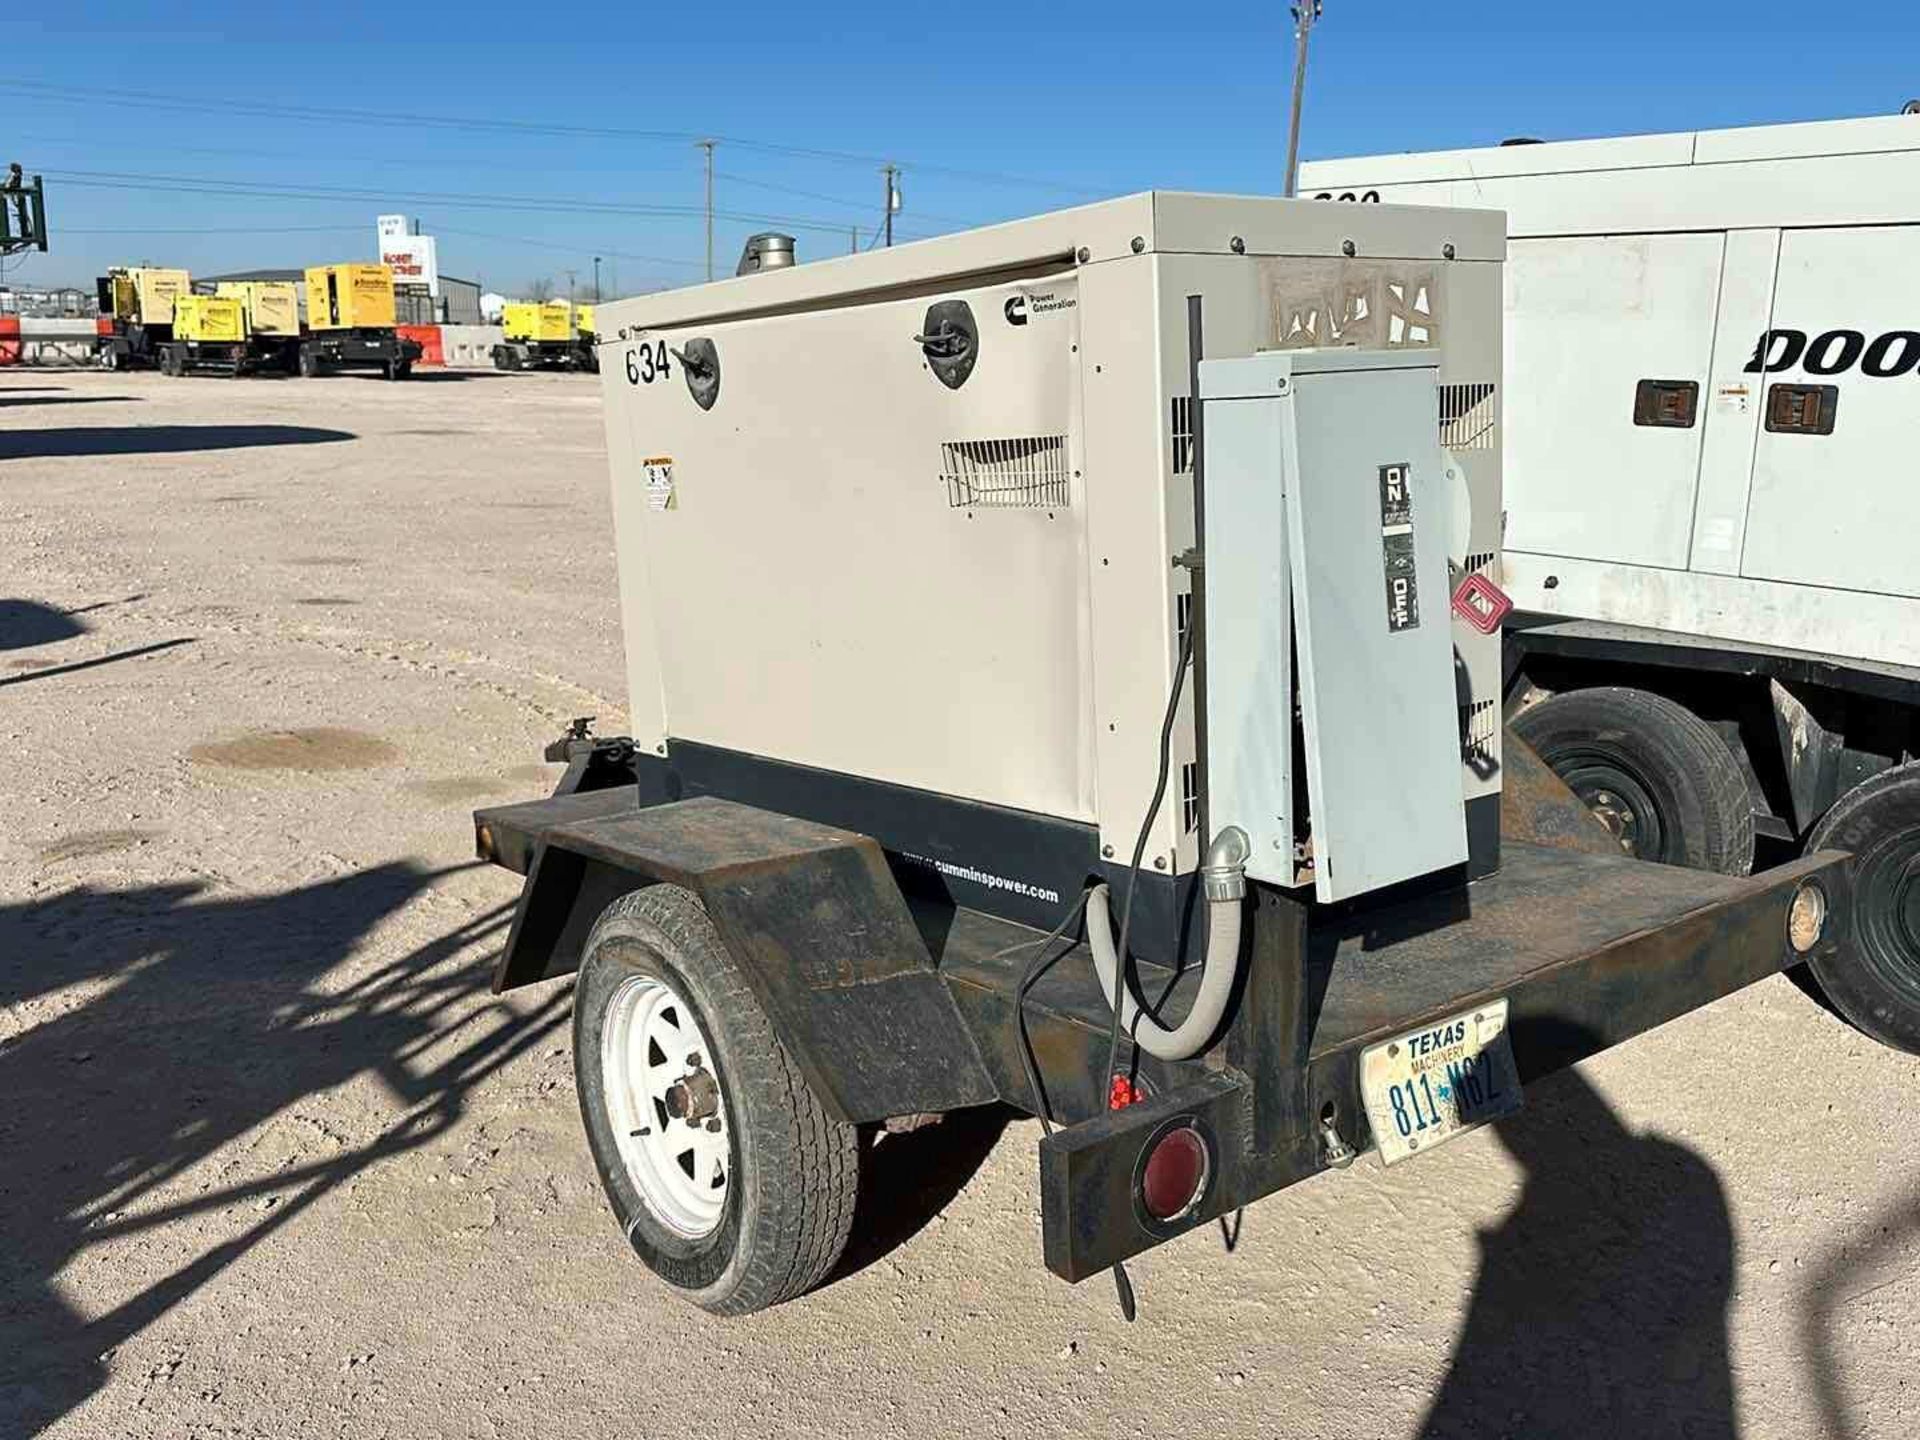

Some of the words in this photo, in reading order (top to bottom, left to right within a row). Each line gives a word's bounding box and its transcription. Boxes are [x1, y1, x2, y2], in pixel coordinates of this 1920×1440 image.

[1030, 293, 1054, 302] Power
[1033, 300, 1076, 312] Generation
[626, 339, 671, 385] 634
[1743, 328, 1920, 378] DOO
[1386, 467, 1402, 502] ON
[1393, 578, 1409, 628] OFF
[1408, 1022, 1465, 1058] TEXAS
[1411, 1045, 1465, 1074] MACHINERY
[1389, 1073, 1441, 1137] 811
